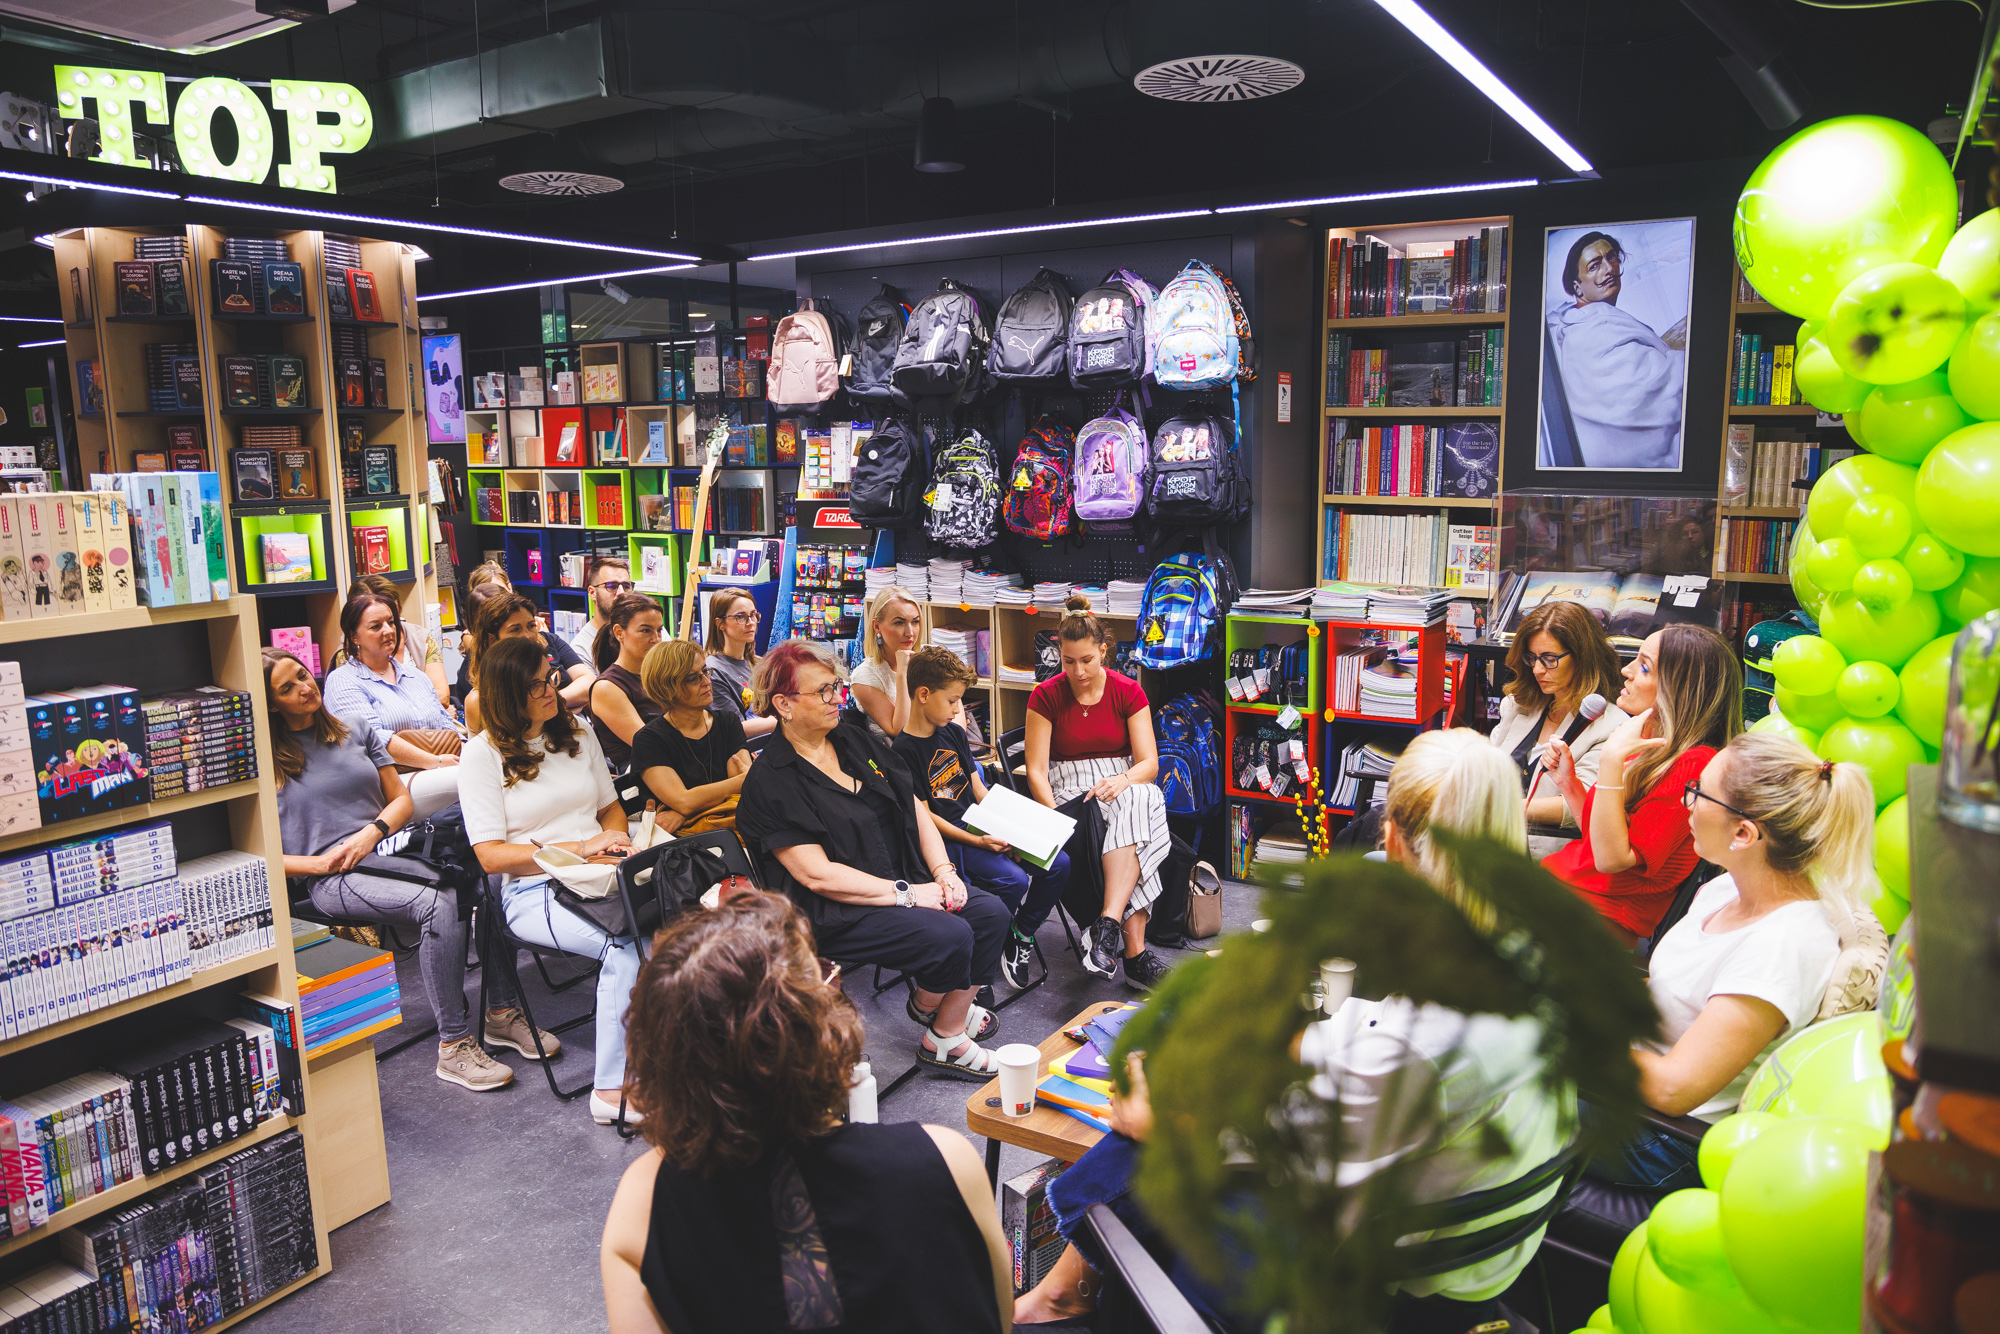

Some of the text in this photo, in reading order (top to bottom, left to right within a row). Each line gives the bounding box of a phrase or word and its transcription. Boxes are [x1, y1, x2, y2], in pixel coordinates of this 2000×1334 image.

[54, 65, 373, 194] TOP
[1330, 261, 1338, 295] ROCKY
[375, 502, 380, 510] 7
[824, 513, 855, 522] TARG
[54, 768, 134, 799] LAST MAN
[57, 846, 91, 859] BLUE LOCK
[57, 855, 93, 868] BLUE LOCK
[60, 864, 94, 877] BLUE LOCK
[62, 872, 97, 886] BLUE LOCK
[62, 889, 97, 904] BLUE LOCK
[136, 891, 148, 919] BLUE LOCK
[106, 898, 119, 927] BLUE LOCK
[77, 906, 89, 936] BLUE LOCK
[45, 914, 58, 945] BLUE LOCK
[5, 925, 16, 959] BLUE LOCK
[165, 963, 174, 973] 20
[183, 958, 190, 967] 22
[118, 977, 126, 987] 15
[128, 974, 136, 984] 16
[88, 987, 97, 996] 12
[48, 1001, 55, 1010] 8
[58, 997, 66, 1006] 9
[68, 994, 77, 1004] 10
[6, 1015, 13, 1024] 5
[19, 1142, 45, 1196] NANA
[0, 1149, 26, 1204] NANA
